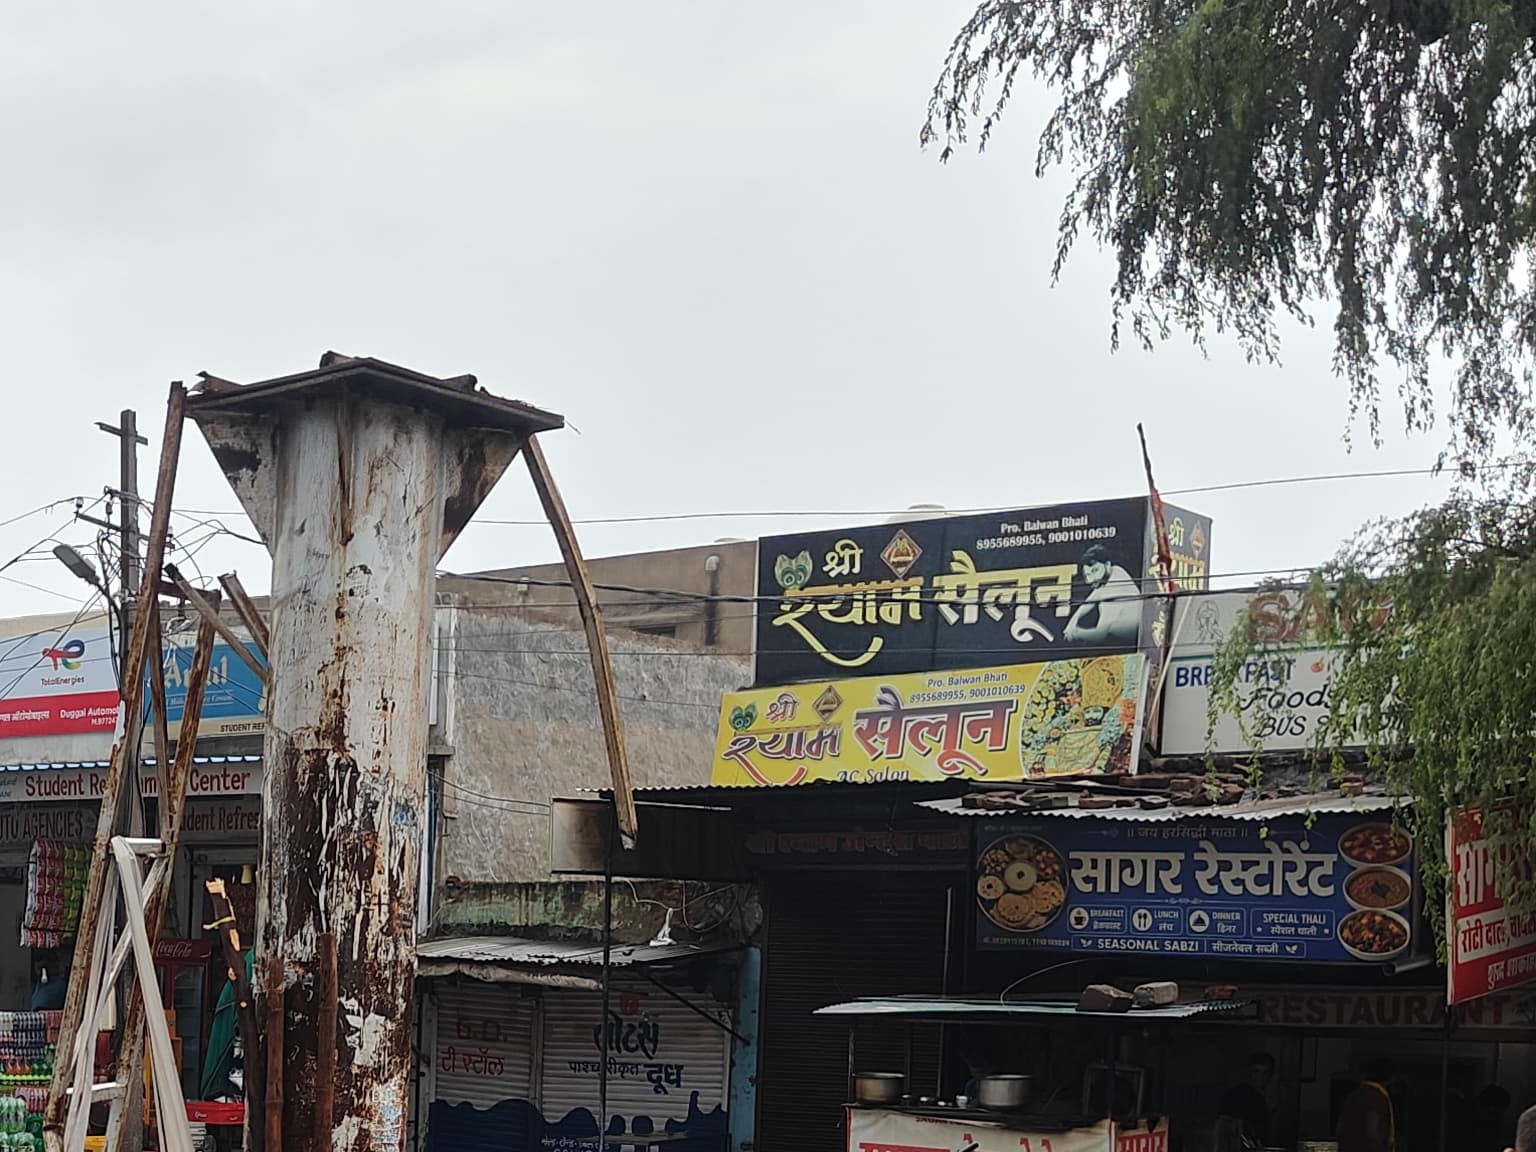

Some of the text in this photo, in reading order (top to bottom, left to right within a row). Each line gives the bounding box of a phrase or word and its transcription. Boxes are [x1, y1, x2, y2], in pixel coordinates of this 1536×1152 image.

[1023, 518, 1059, 533] Balwan
[1062, 515, 1088, 529] Bhati
[821, 539, 864, 578] श्री
[772, 550, 1079, 667] श्याम सैलून
[41, 676, 85, 687] TotalEnergies
[928, 671, 1008, 688] Pro. Balwan Bhati
[1175, 658, 1296, 688] BREFAST
[969, 684, 1026, 700] 9001010639
[60, 708, 86, 719] Duggal
[765, 692, 799, 722] श्री
[220, 723, 250, 733] STUDENT
[722, 685, 1019, 786] श्याम सैलून
[25, 773, 84, 797] Student
[189, 768, 251, 793] Center
[1068, 840, 1338, 897] सागर रेस्टोरेंट
[1154, 910, 1179, 919] LUNCH
[1212, 911, 1240, 921] DINNER
[1263, 912, 1327, 925] SPECIAL THALI
[1097, 938, 1199, 951] SEASONAL SABZI
[440, 1047, 457, 1073] टी
[642, 1064, 685, 1094] दूध
